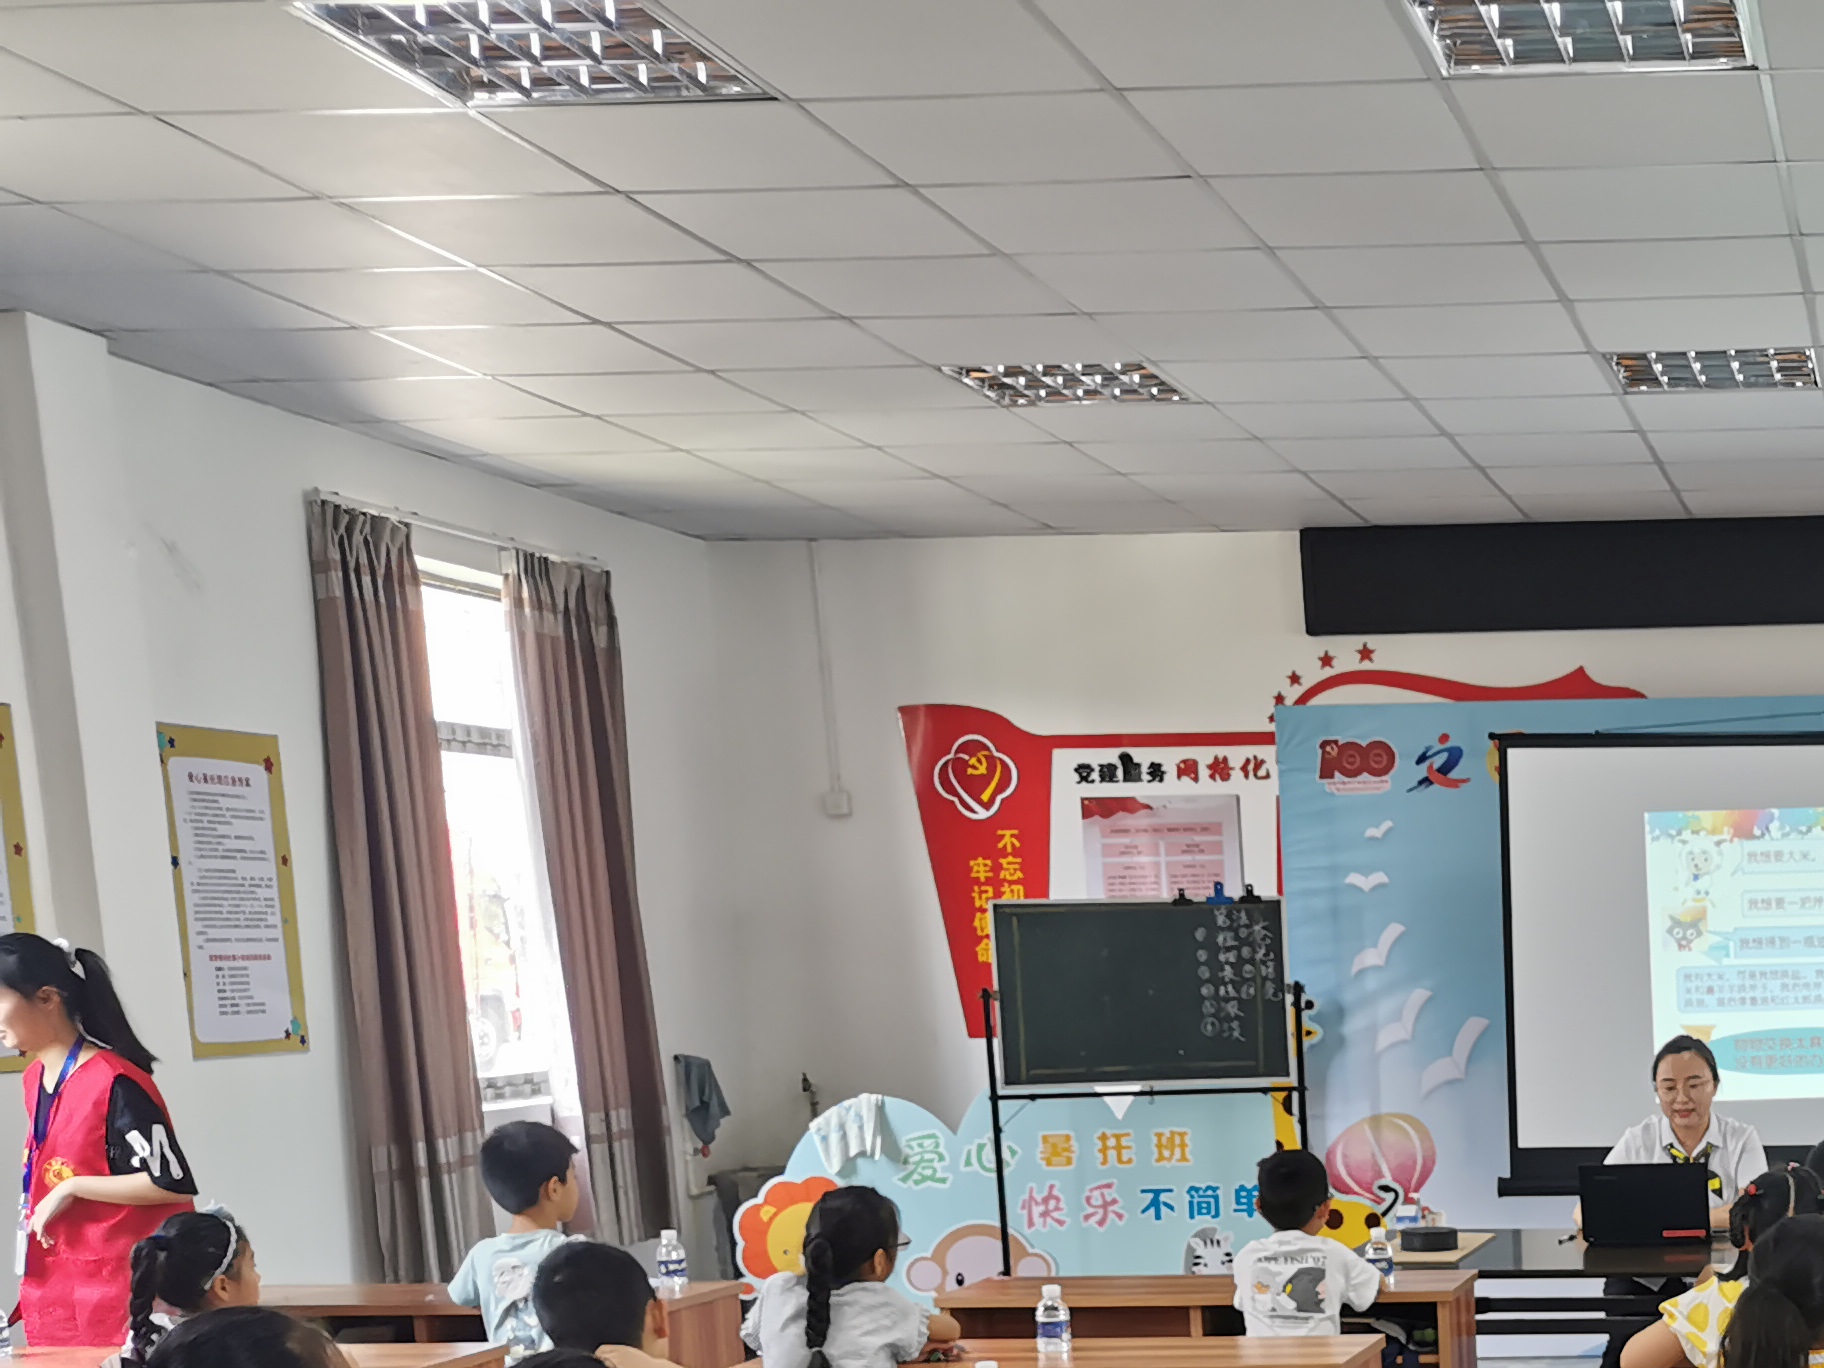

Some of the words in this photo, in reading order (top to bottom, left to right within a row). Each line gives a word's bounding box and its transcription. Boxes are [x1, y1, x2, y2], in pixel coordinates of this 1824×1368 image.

[899, 1130, 1193, 1185] 爱心暑托班
[1020, 1181, 1260, 1230] 快乐不简单
